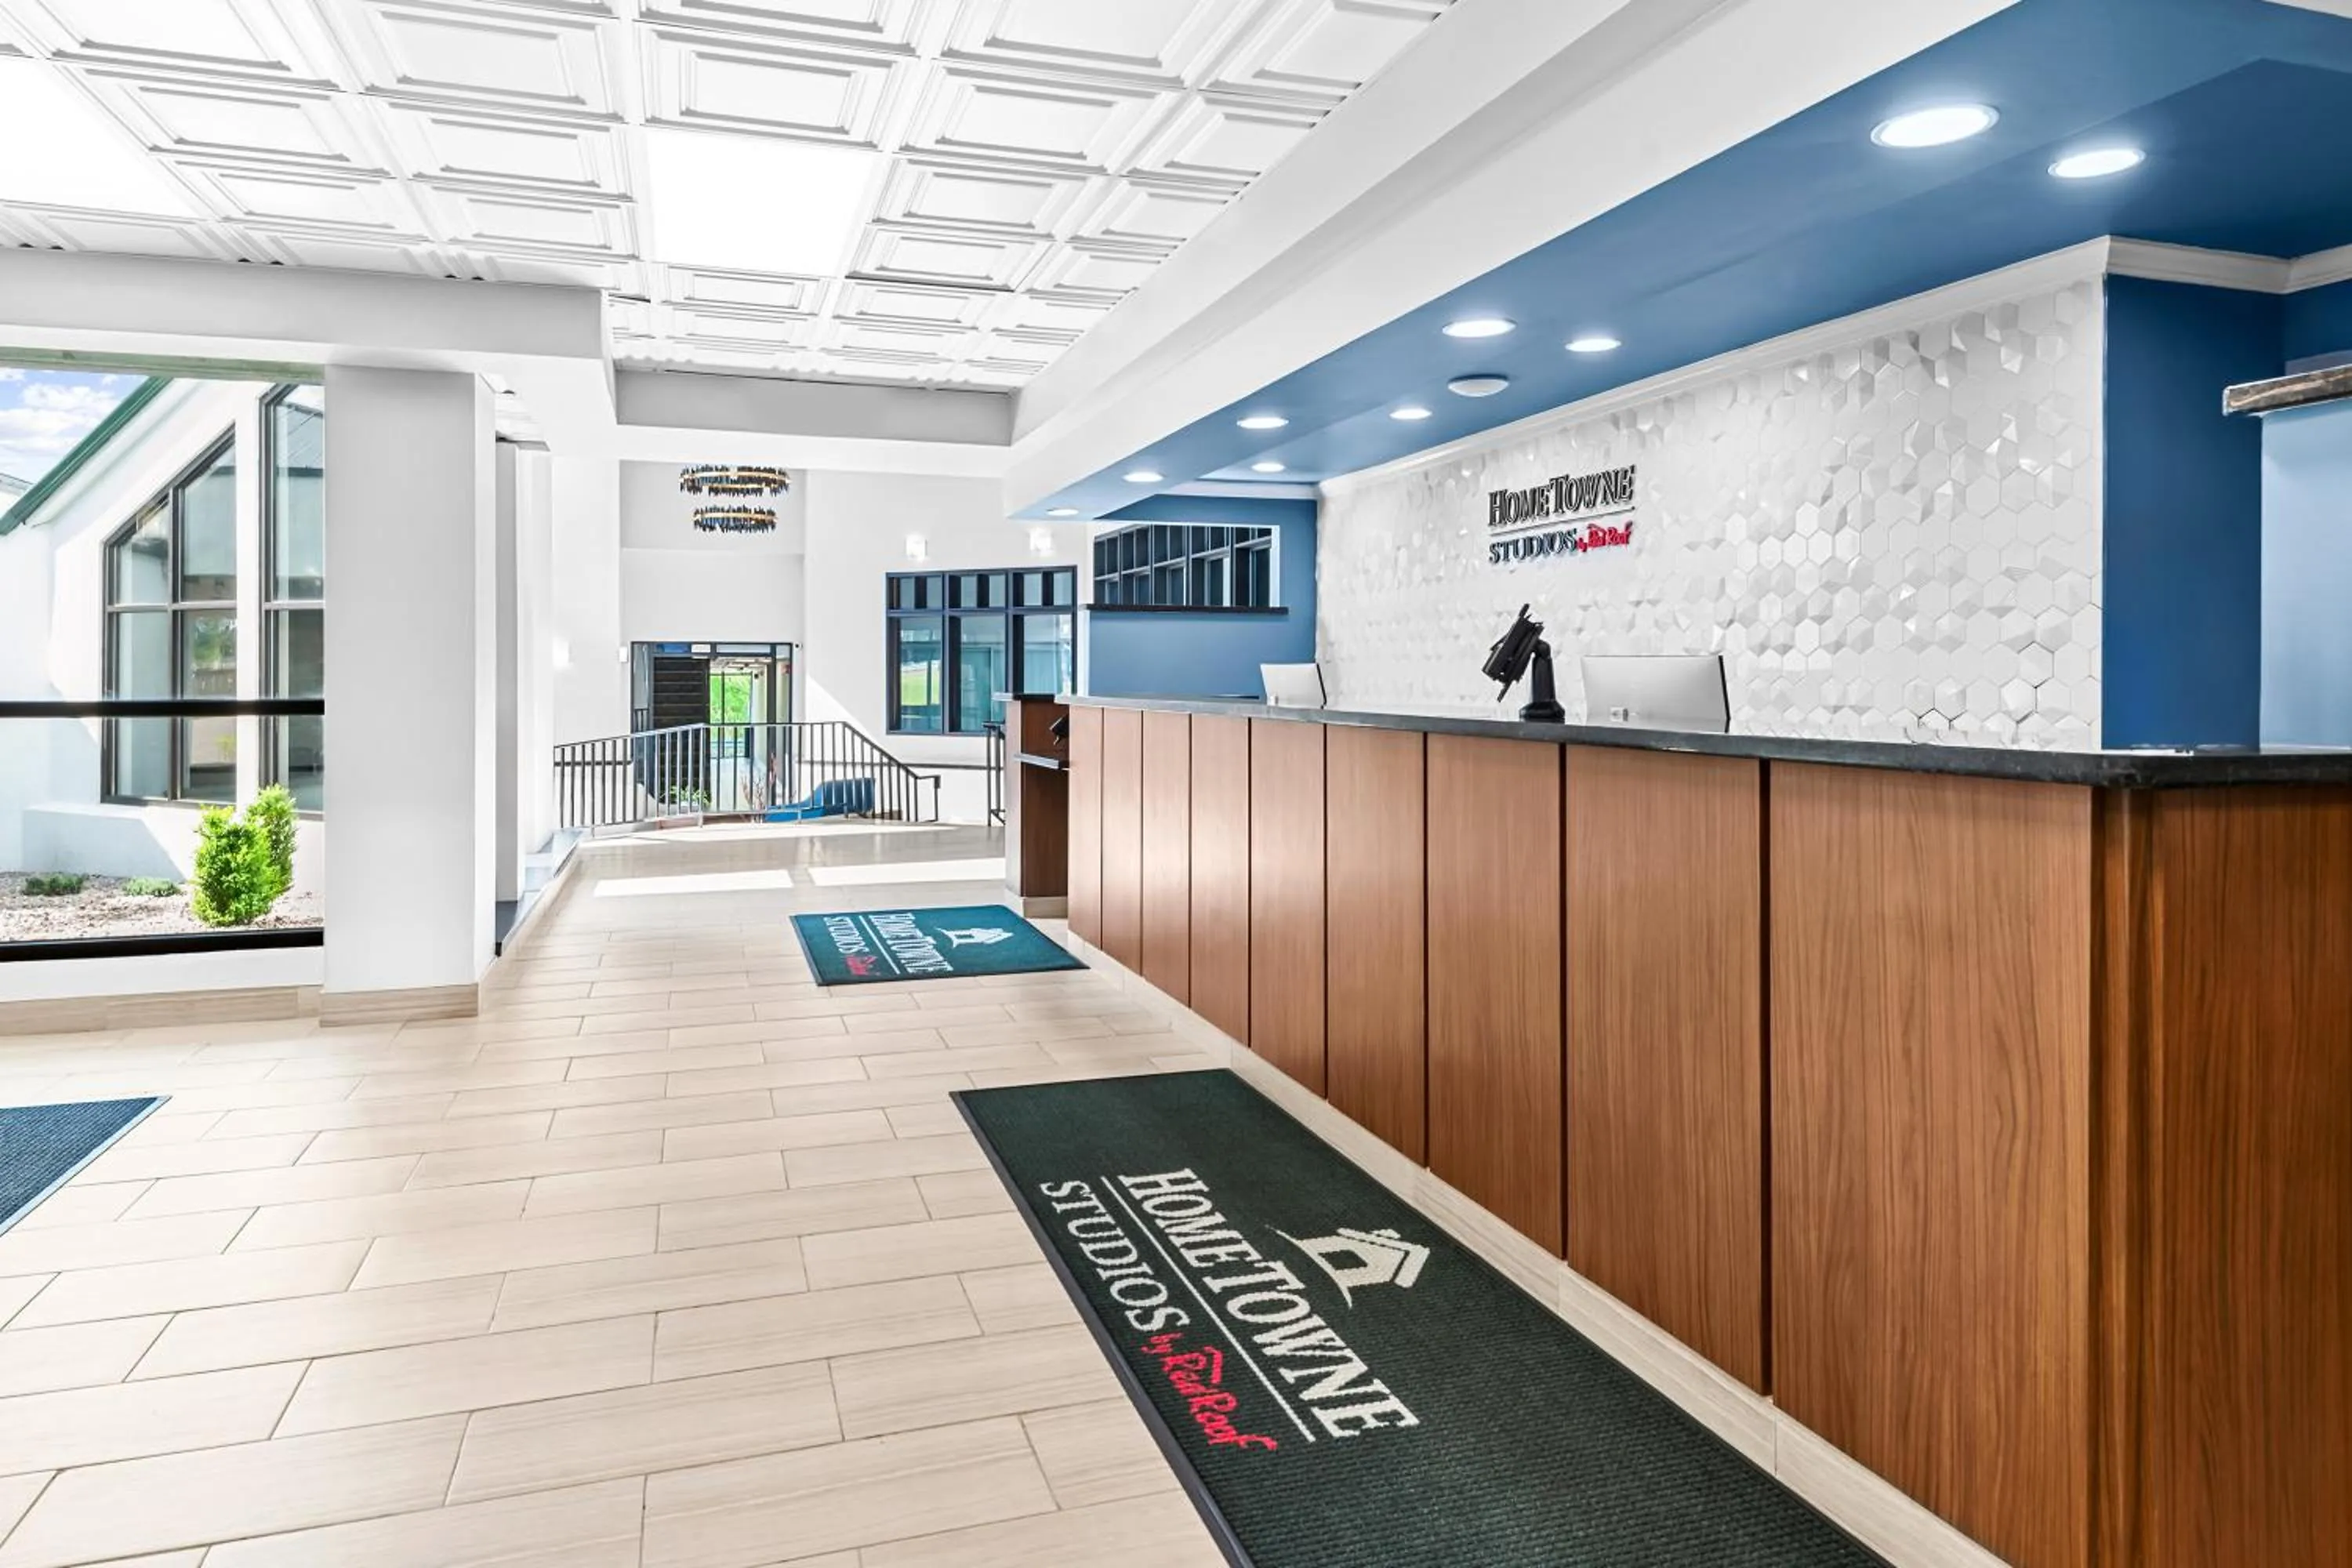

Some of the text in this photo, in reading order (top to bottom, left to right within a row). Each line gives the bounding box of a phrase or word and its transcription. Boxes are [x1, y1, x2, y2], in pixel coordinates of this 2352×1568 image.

[1489, 528, 1577, 564] STUDIOS
[823, 916, 870, 954] STUDIOS
[1040, 1179, 1190, 1331] STUDIOS
[1140, 1332, 1185, 1355] by
